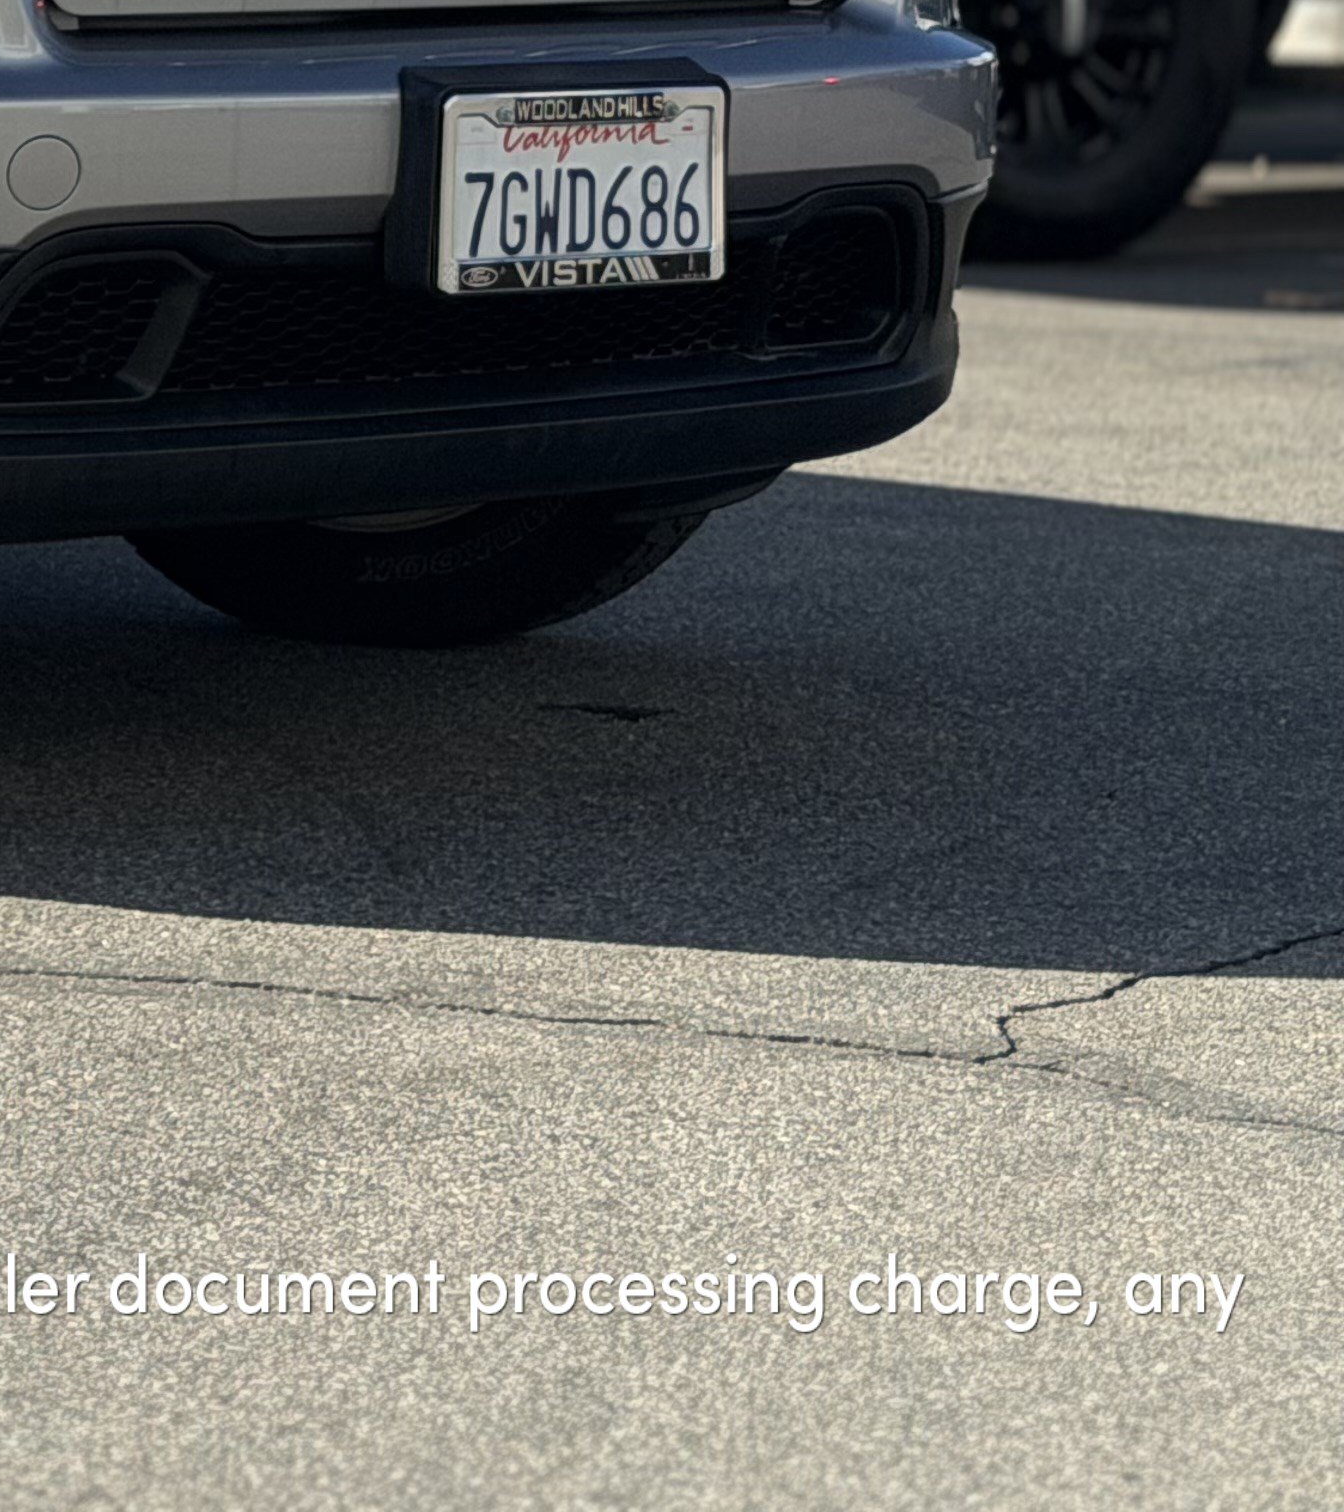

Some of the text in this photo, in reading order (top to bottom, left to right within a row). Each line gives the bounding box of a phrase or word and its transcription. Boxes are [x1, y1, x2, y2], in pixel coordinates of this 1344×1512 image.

[517, 95, 664, 121] WOODLAND HILLS
[465, 162, 700, 257] 7GWD686
[515, 257, 627, 288] VISTA
